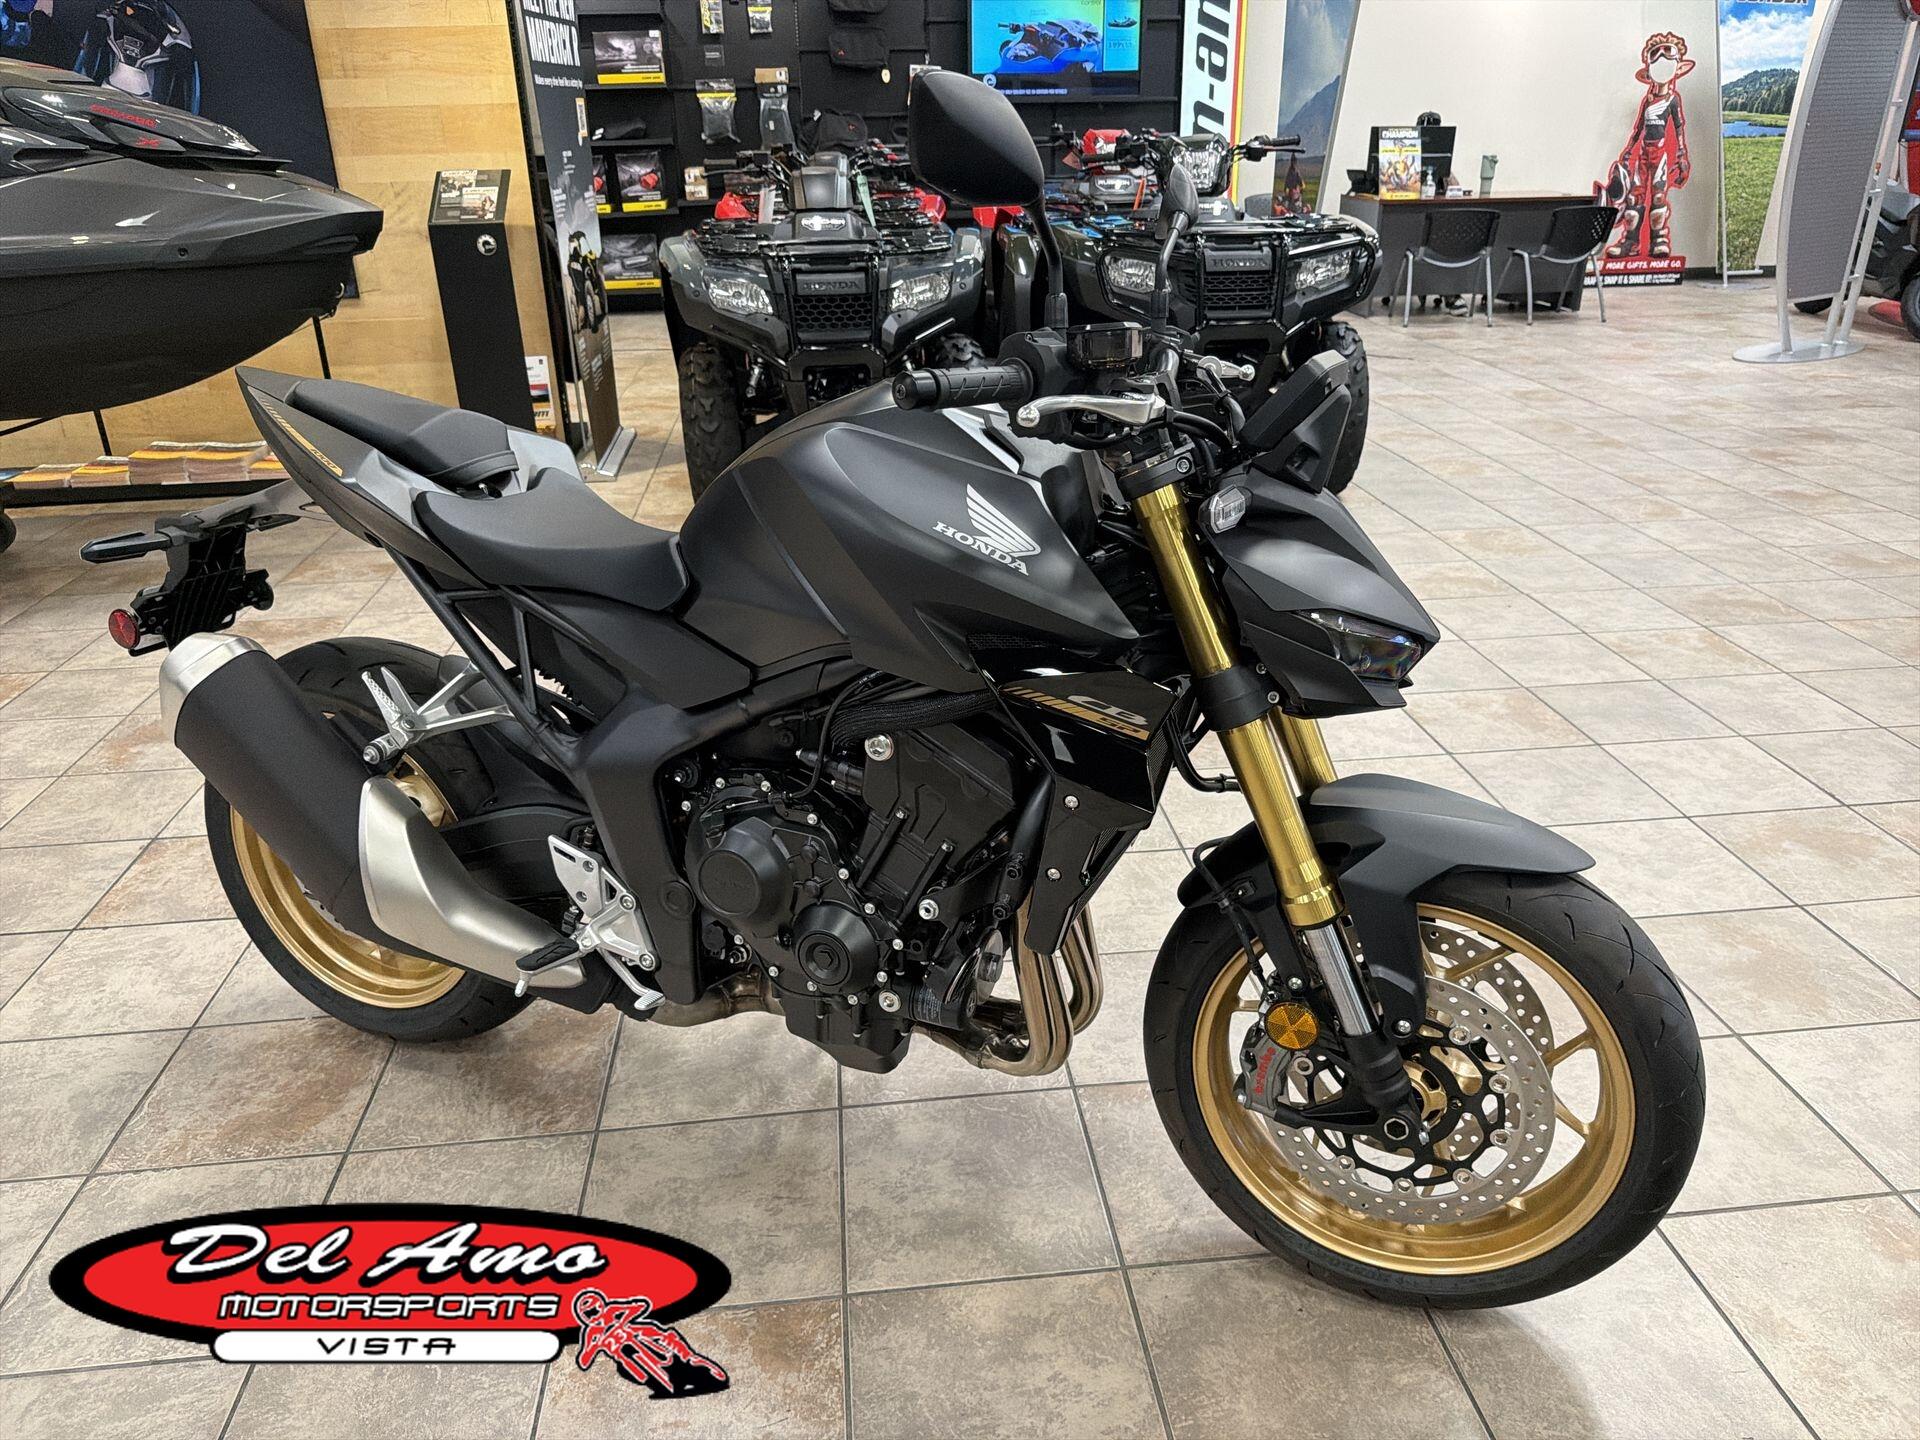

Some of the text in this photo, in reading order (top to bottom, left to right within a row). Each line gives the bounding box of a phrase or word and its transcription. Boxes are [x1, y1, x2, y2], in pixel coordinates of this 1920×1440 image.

[525, 15, 580, 67] MAVERICK R
[1382, 130, 1419, 139] CHAMPION
[1211, 259, 1268, 267] HONDA
[1605, 261, 1625, 269] MORE
[1627, 261, 1648, 269] GIFTS.
[1650, 260, 1669, 268] MORE
[803, 281, 860, 290] HONDA
[932, 521, 1029, 576] HONDA
[1067, 695, 1148, 725] CB
[1096, 717, 1142, 734] SP
[1254, 1046, 1276, 1097] brembo
